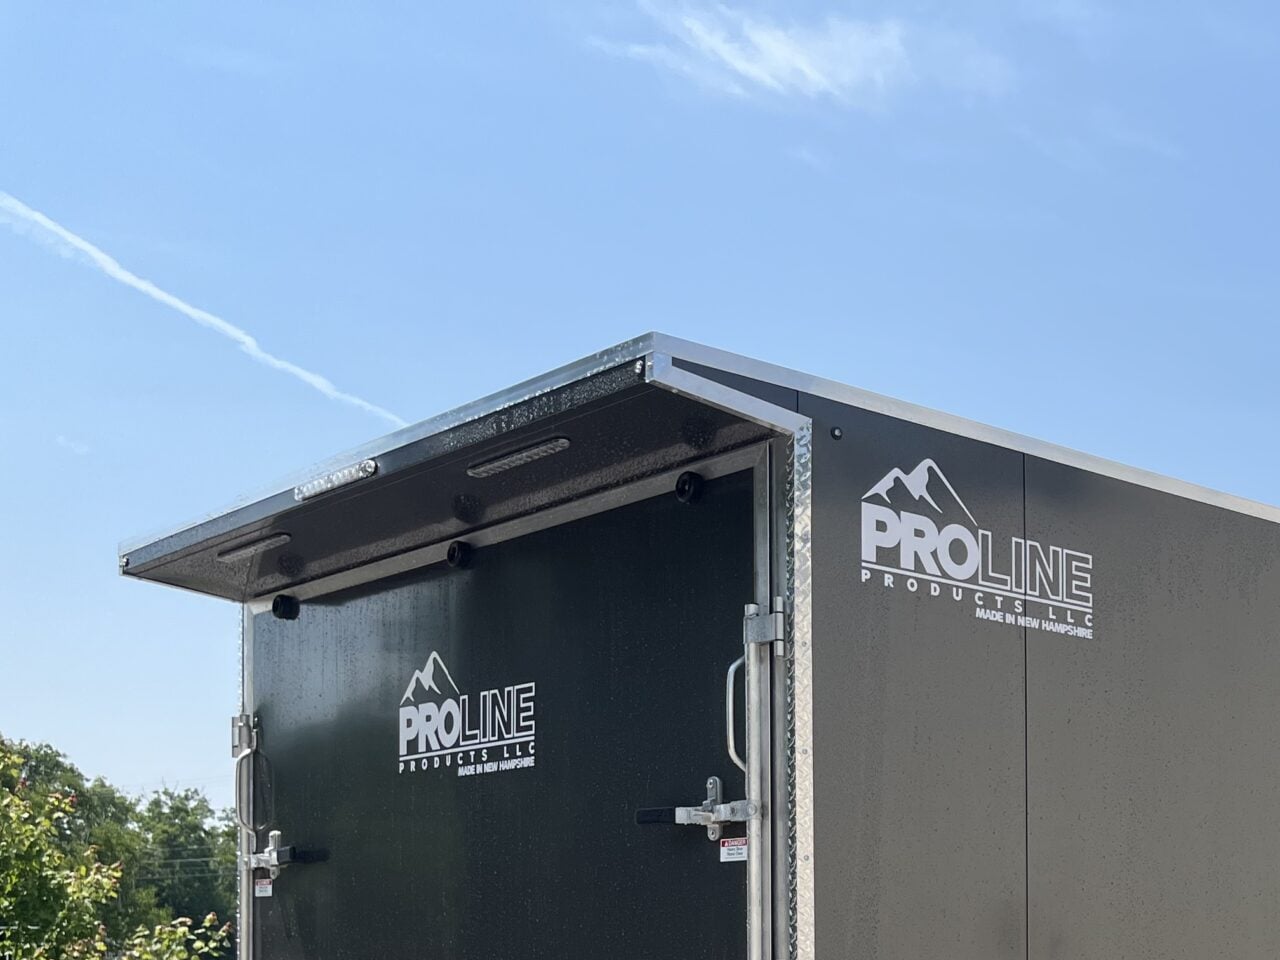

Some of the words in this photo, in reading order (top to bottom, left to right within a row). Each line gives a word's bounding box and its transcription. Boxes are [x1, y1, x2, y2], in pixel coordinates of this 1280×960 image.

[861, 501, 1093, 607] PROLINE
[861, 569, 1023, 613] PRODUCTS
[1048, 606, 1093, 627] LLC
[975, 607, 1004, 623] MADE
[1005, 612, 1016, 625] IN
[1017, 615, 1040, 629] NEW
[1041, 620, 1093, 639] HAMPSHIRE
[399, 682, 535, 755] PROLINE
[399, 749, 488, 774] PRODUCTS
[503, 741, 535, 758] LLC
[457, 764, 476, 777] MADE
[476, 763, 483, 774] IN
[483, 760, 499, 773] NEW
[499, 755, 535, 771] HAMPSHIRE
